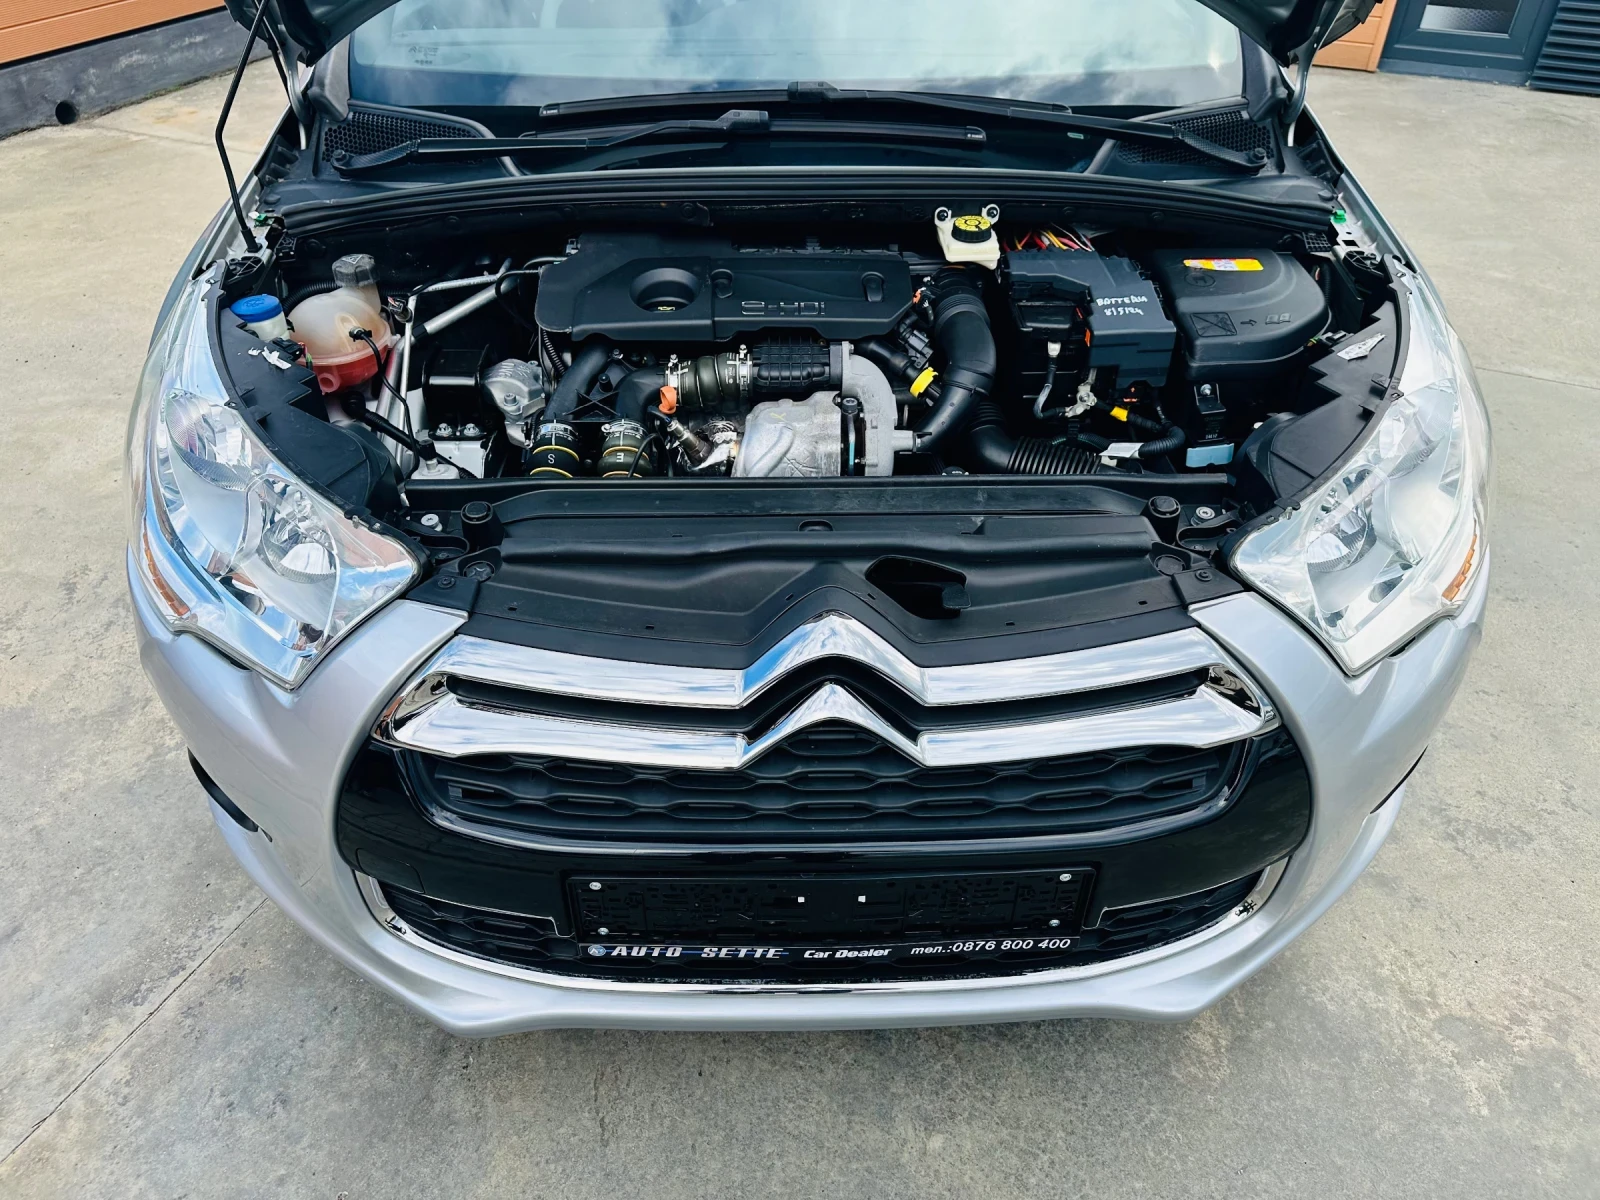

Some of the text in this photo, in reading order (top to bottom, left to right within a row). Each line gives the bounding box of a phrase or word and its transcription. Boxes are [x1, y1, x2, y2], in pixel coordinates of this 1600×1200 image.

[547, 453, 556, 464] S
[1001, 939, 1034, 950] 800
[1037, 938, 1071, 949] 400
[611, 946, 893, 959] AUTO SETTE Car Dealer
